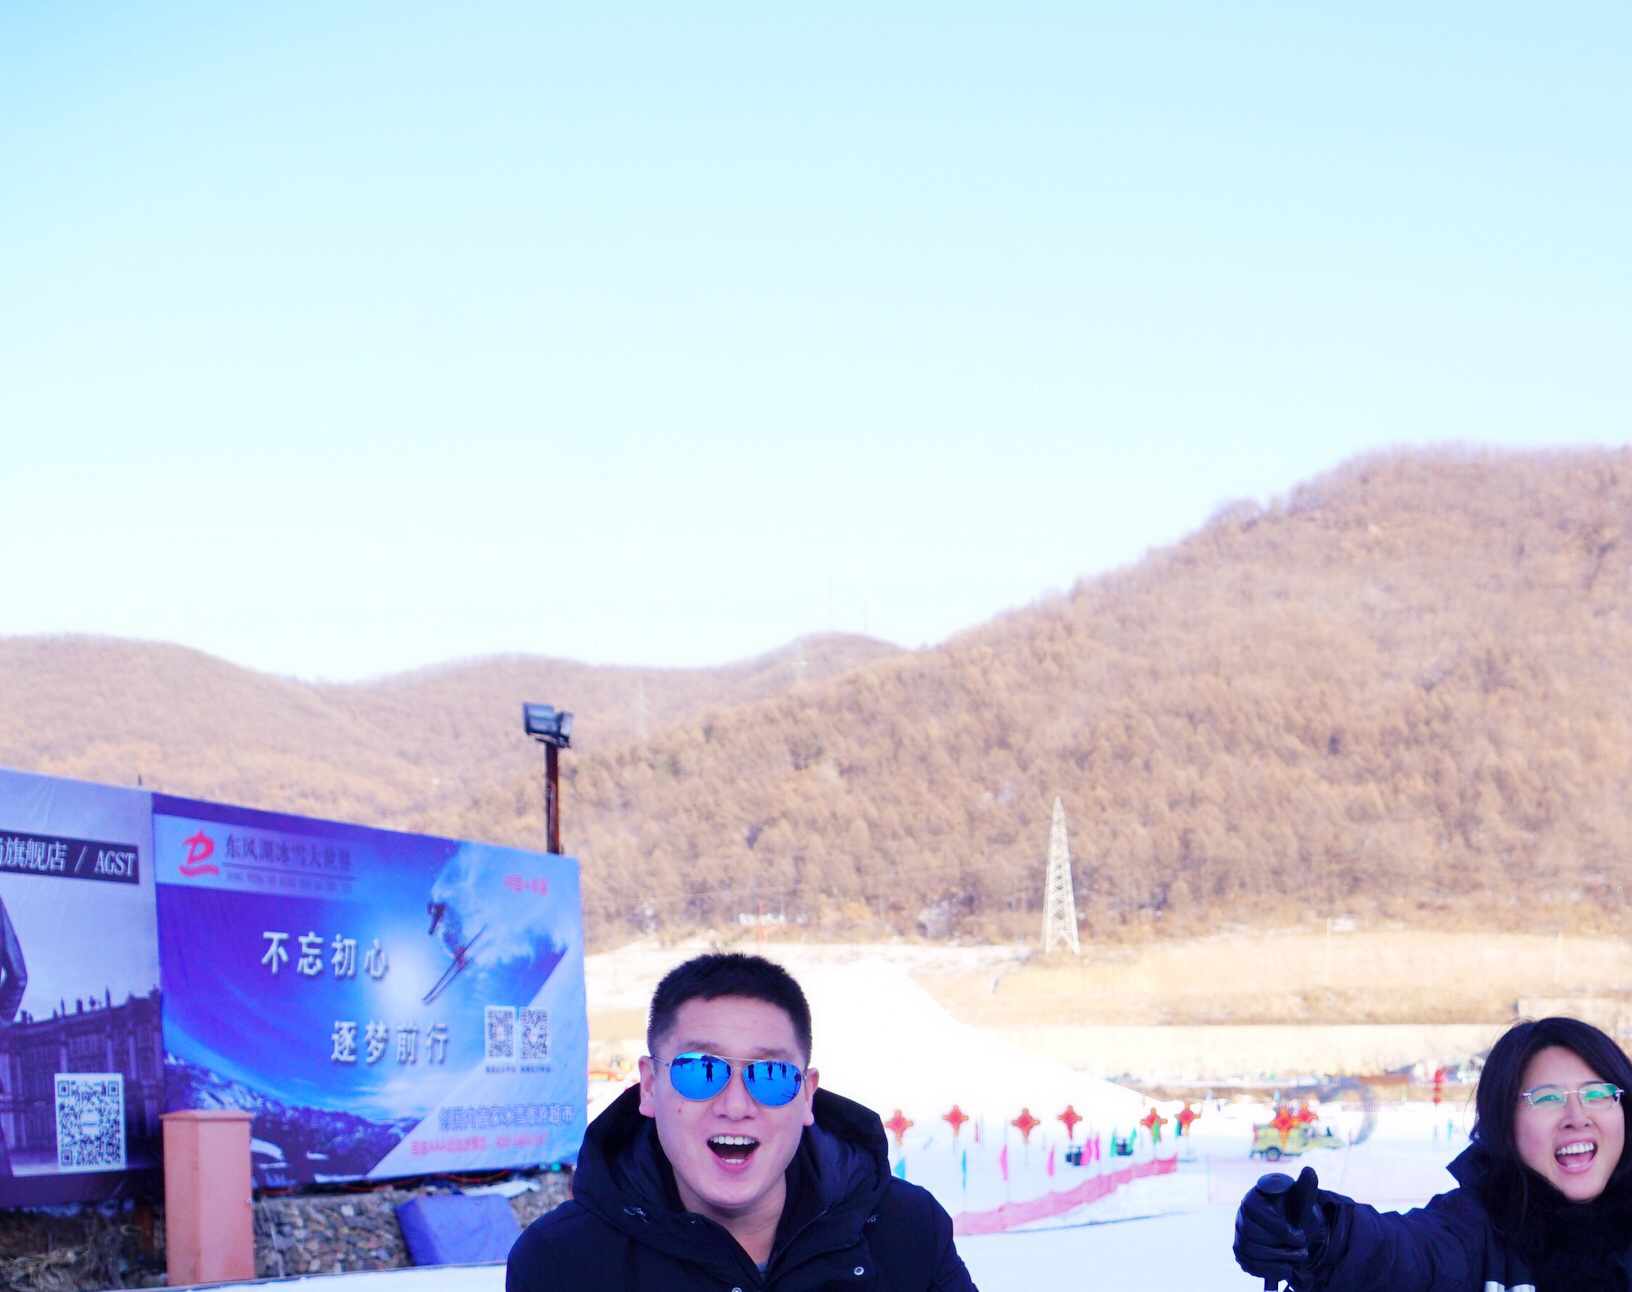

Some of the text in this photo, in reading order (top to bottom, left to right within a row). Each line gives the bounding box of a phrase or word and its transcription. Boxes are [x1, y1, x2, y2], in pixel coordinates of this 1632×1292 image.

[0, 836, 68, 872] 旗舰店
[94, 849, 137, 877] AGST
[261, 931, 389, 980] 不忘初心
[331, 1020, 449, 1065] 逐梦前行
